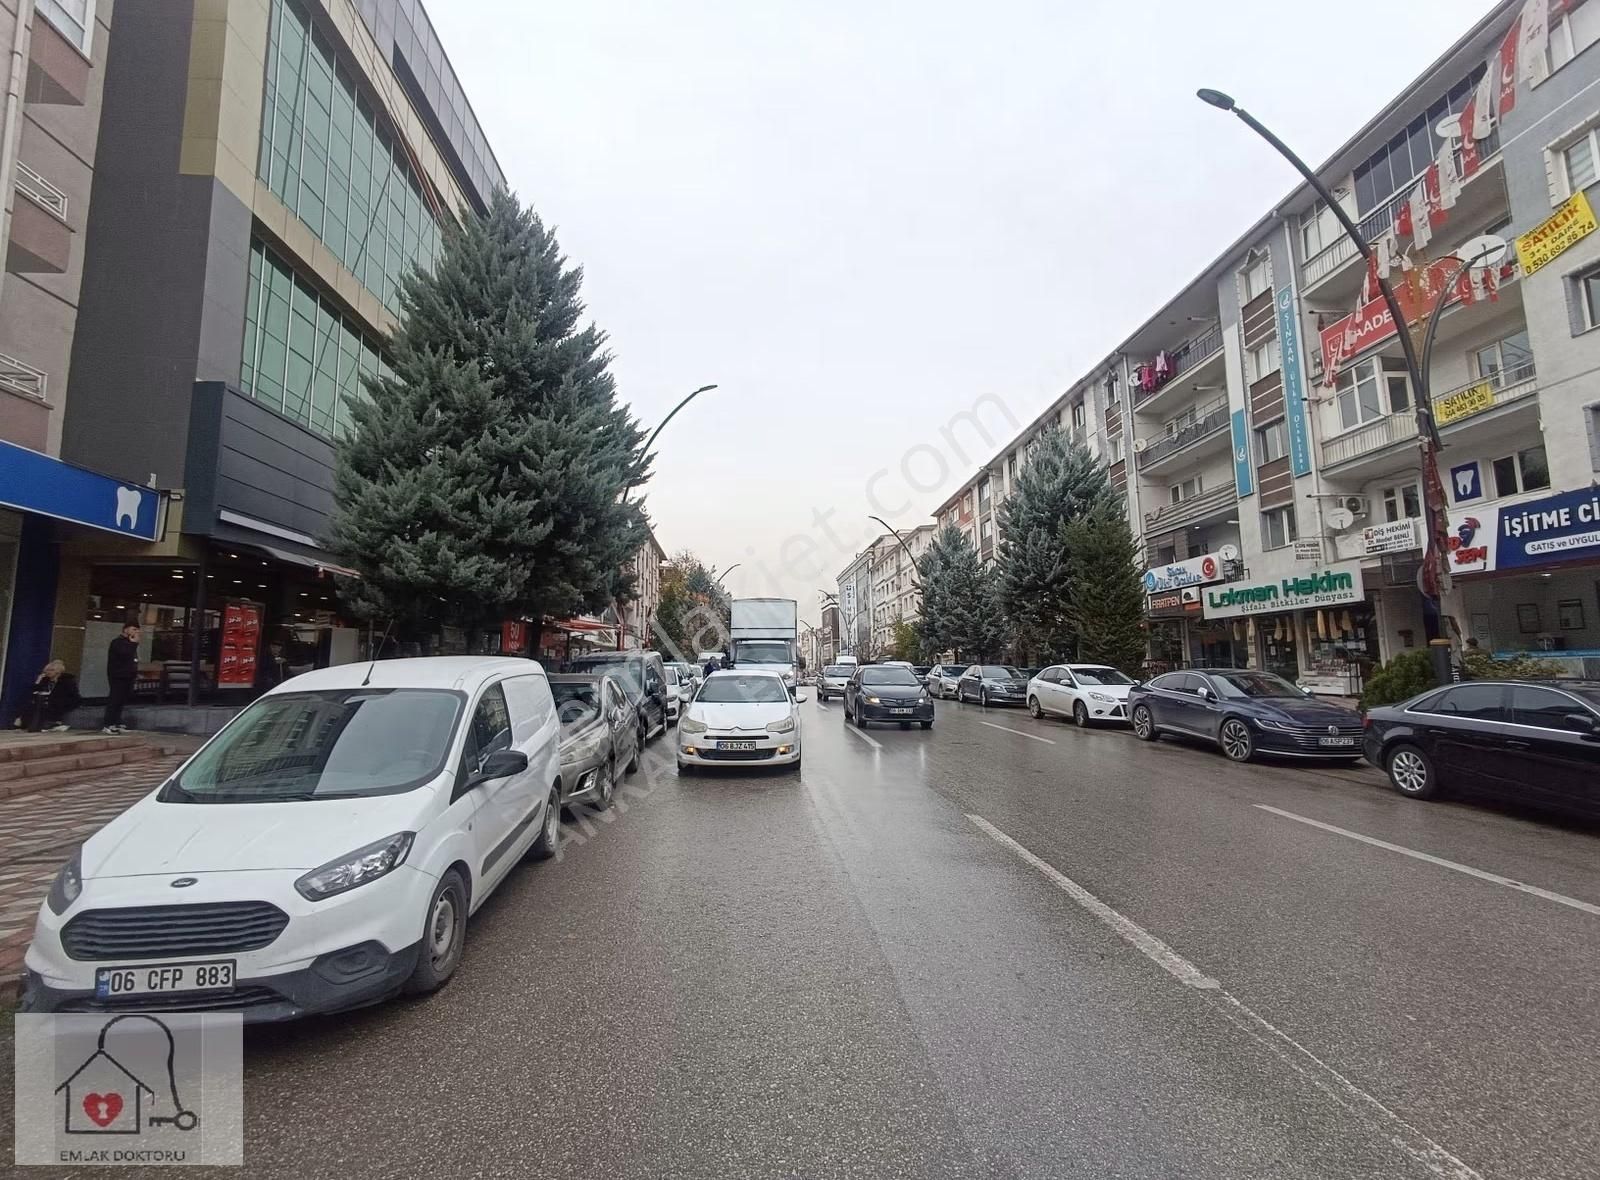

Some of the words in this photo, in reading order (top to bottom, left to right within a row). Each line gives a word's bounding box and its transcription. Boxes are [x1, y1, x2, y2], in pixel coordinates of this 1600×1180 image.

[1521, 204, 1579, 252] SATILIK
[1525, 265, 1532, 274] 0
[1532, 253, 1549, 269] 530
[1444, 387, 1480, 409] SATILIK
[1386, 522, 1411, 534] HEKİMİ
[1503, 507, 1571, 538] İŞİTME
[1577, 497, 1600, 523] Cİ
[1455, 546, 1487, 565] SEM
[1530, 542, 1555, 553] SATIŞ
[1556, 540, 1567, 549] ve
[1208, 584, 1278, 608] Lokman
[1282, 570, 1352, 598] Hekim
[1271, 597, 1309, 608] Bitkiler
[111, 971, 135, 992] 06
[147, 968, 183, 990] CFP
[196, 965, 231, 986] 883
